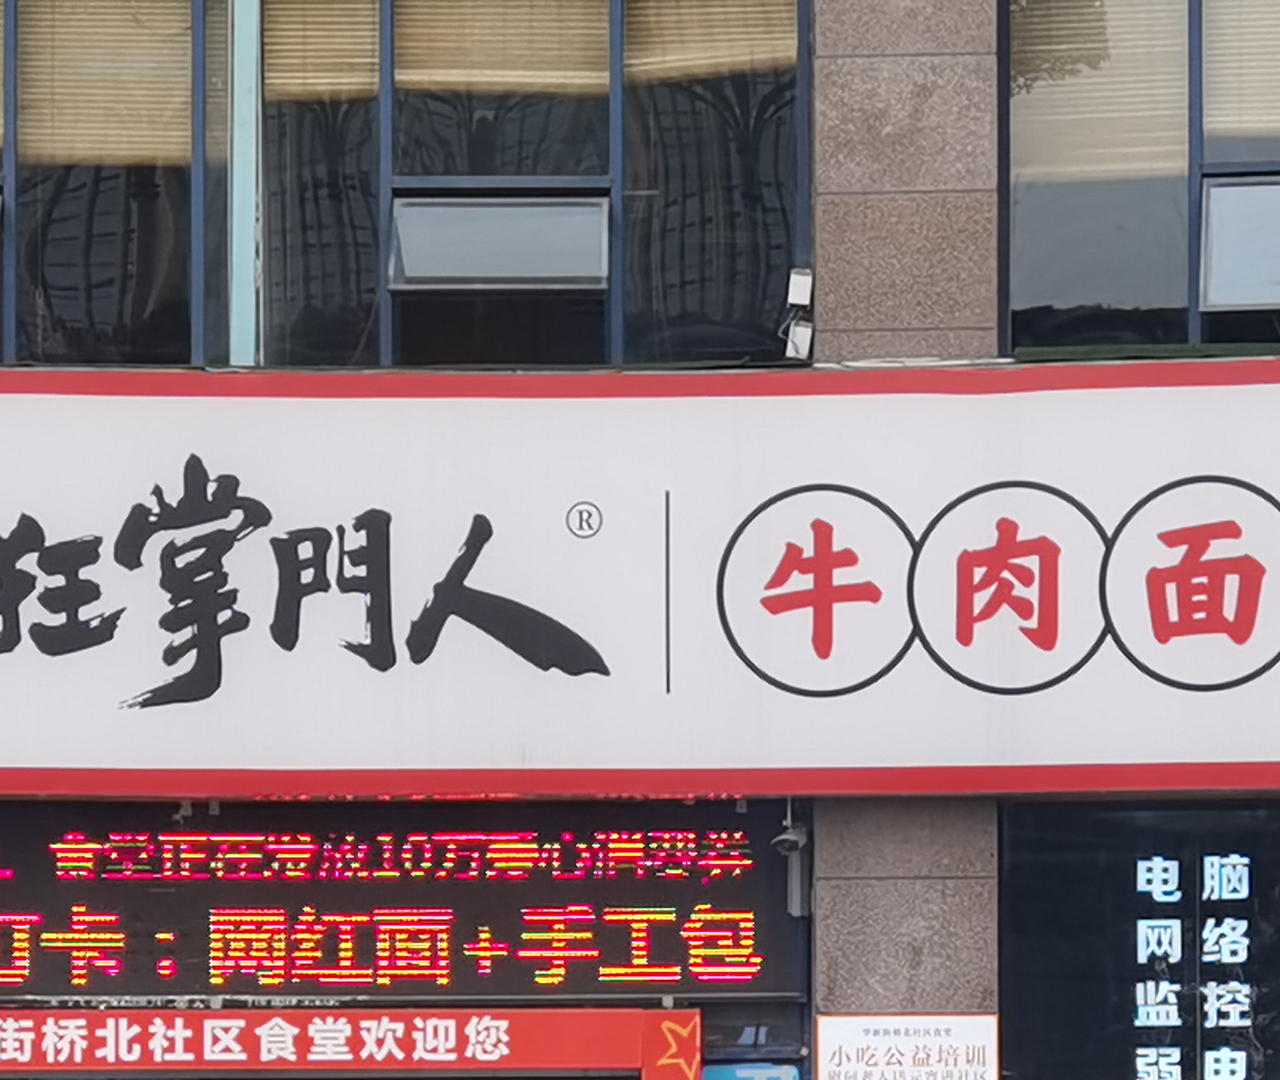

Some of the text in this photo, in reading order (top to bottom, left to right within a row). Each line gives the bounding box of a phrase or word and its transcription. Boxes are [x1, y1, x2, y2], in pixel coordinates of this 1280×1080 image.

[1136, 854, 1251, 903] 电脑
[1136, 918, 1251, 965] 网络
[1134, 981, 1252, 1028] 监控
[828, 1043, 988, 1069] 小吃公益培训
